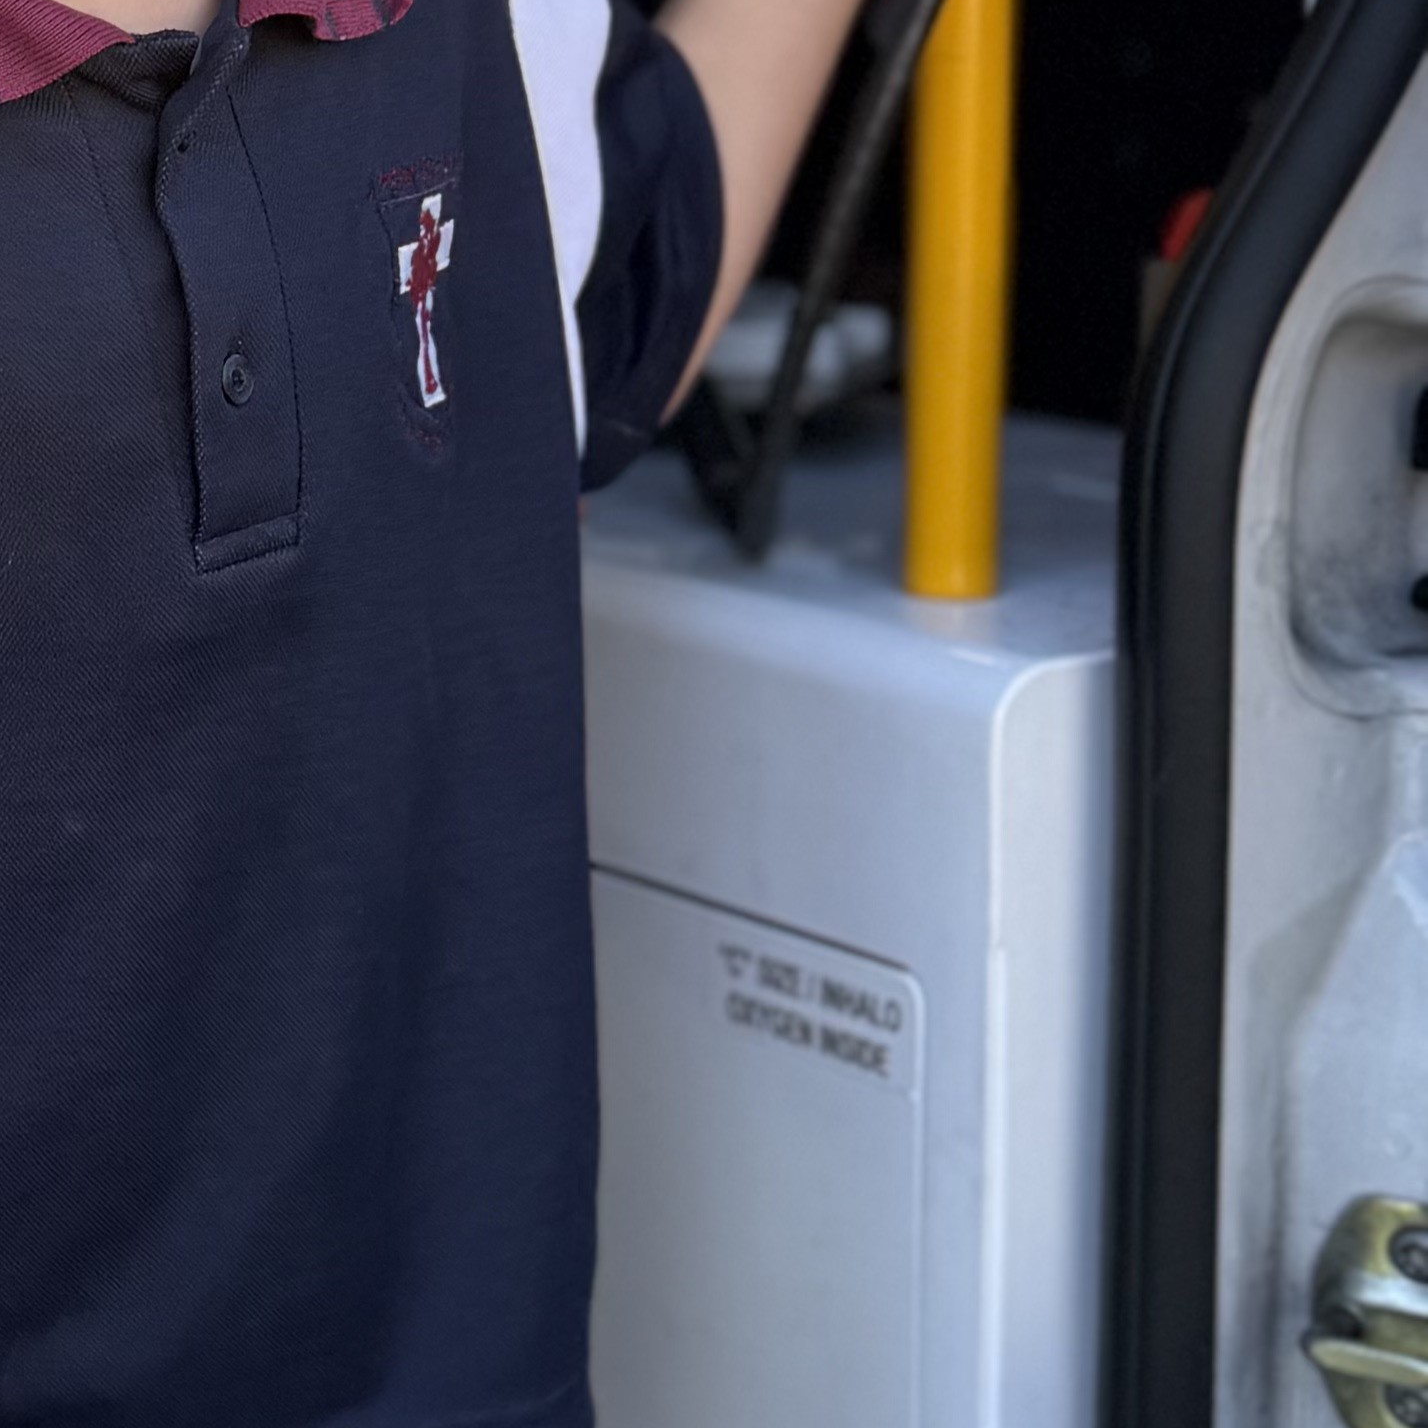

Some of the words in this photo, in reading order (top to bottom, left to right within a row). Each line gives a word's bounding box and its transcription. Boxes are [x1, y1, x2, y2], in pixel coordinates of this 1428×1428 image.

[726, 990, 812, 1047] OXYGEN
[819, 1024, 890, 1079] INSIDE
[757, 956, 800, 1000] SIZE
[820, 976, 903, 1034] INHALO
